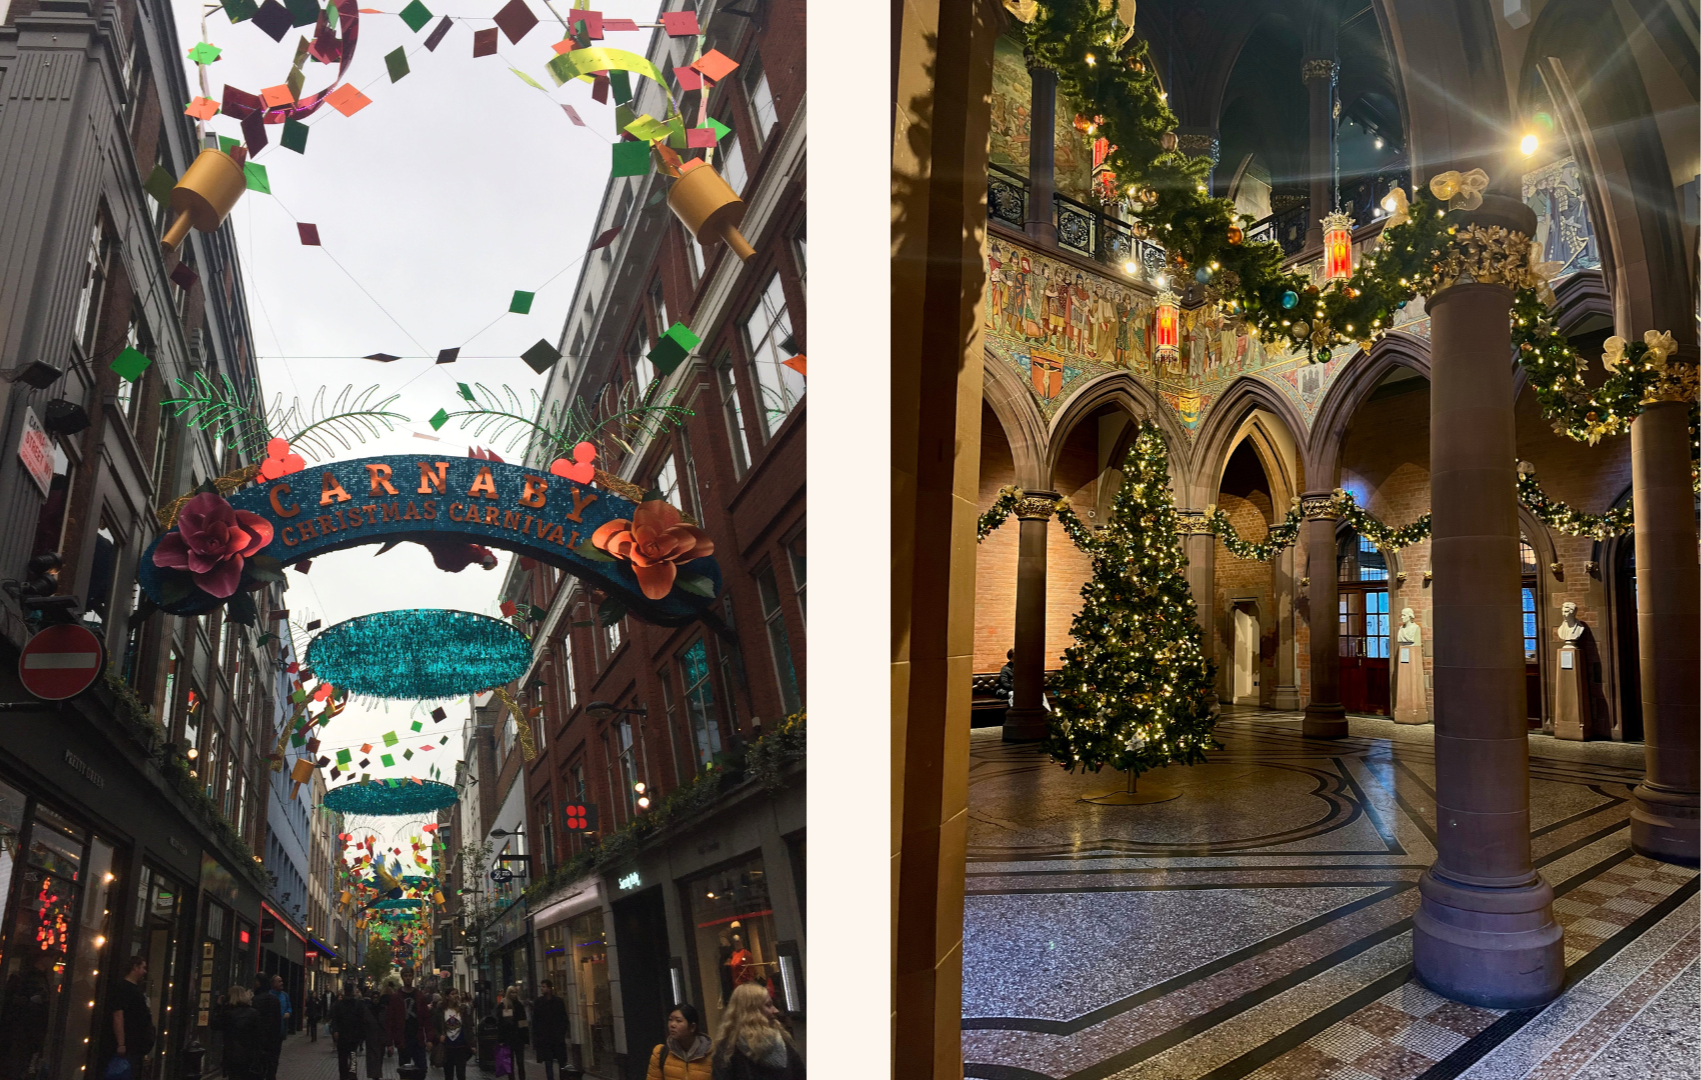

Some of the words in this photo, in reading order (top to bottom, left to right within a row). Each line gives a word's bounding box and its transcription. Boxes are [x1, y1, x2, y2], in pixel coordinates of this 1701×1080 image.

[24, 431, 45, 466] STREET
[269, 462, 598, 523] CARNABY
[281, 501, 437, 547] CHRISTMAS
[449, 503, 580, 550] CARNIVAL
[64, 749, 87, 775] PRETTY
[86, 767, 104, 789] GREEN
